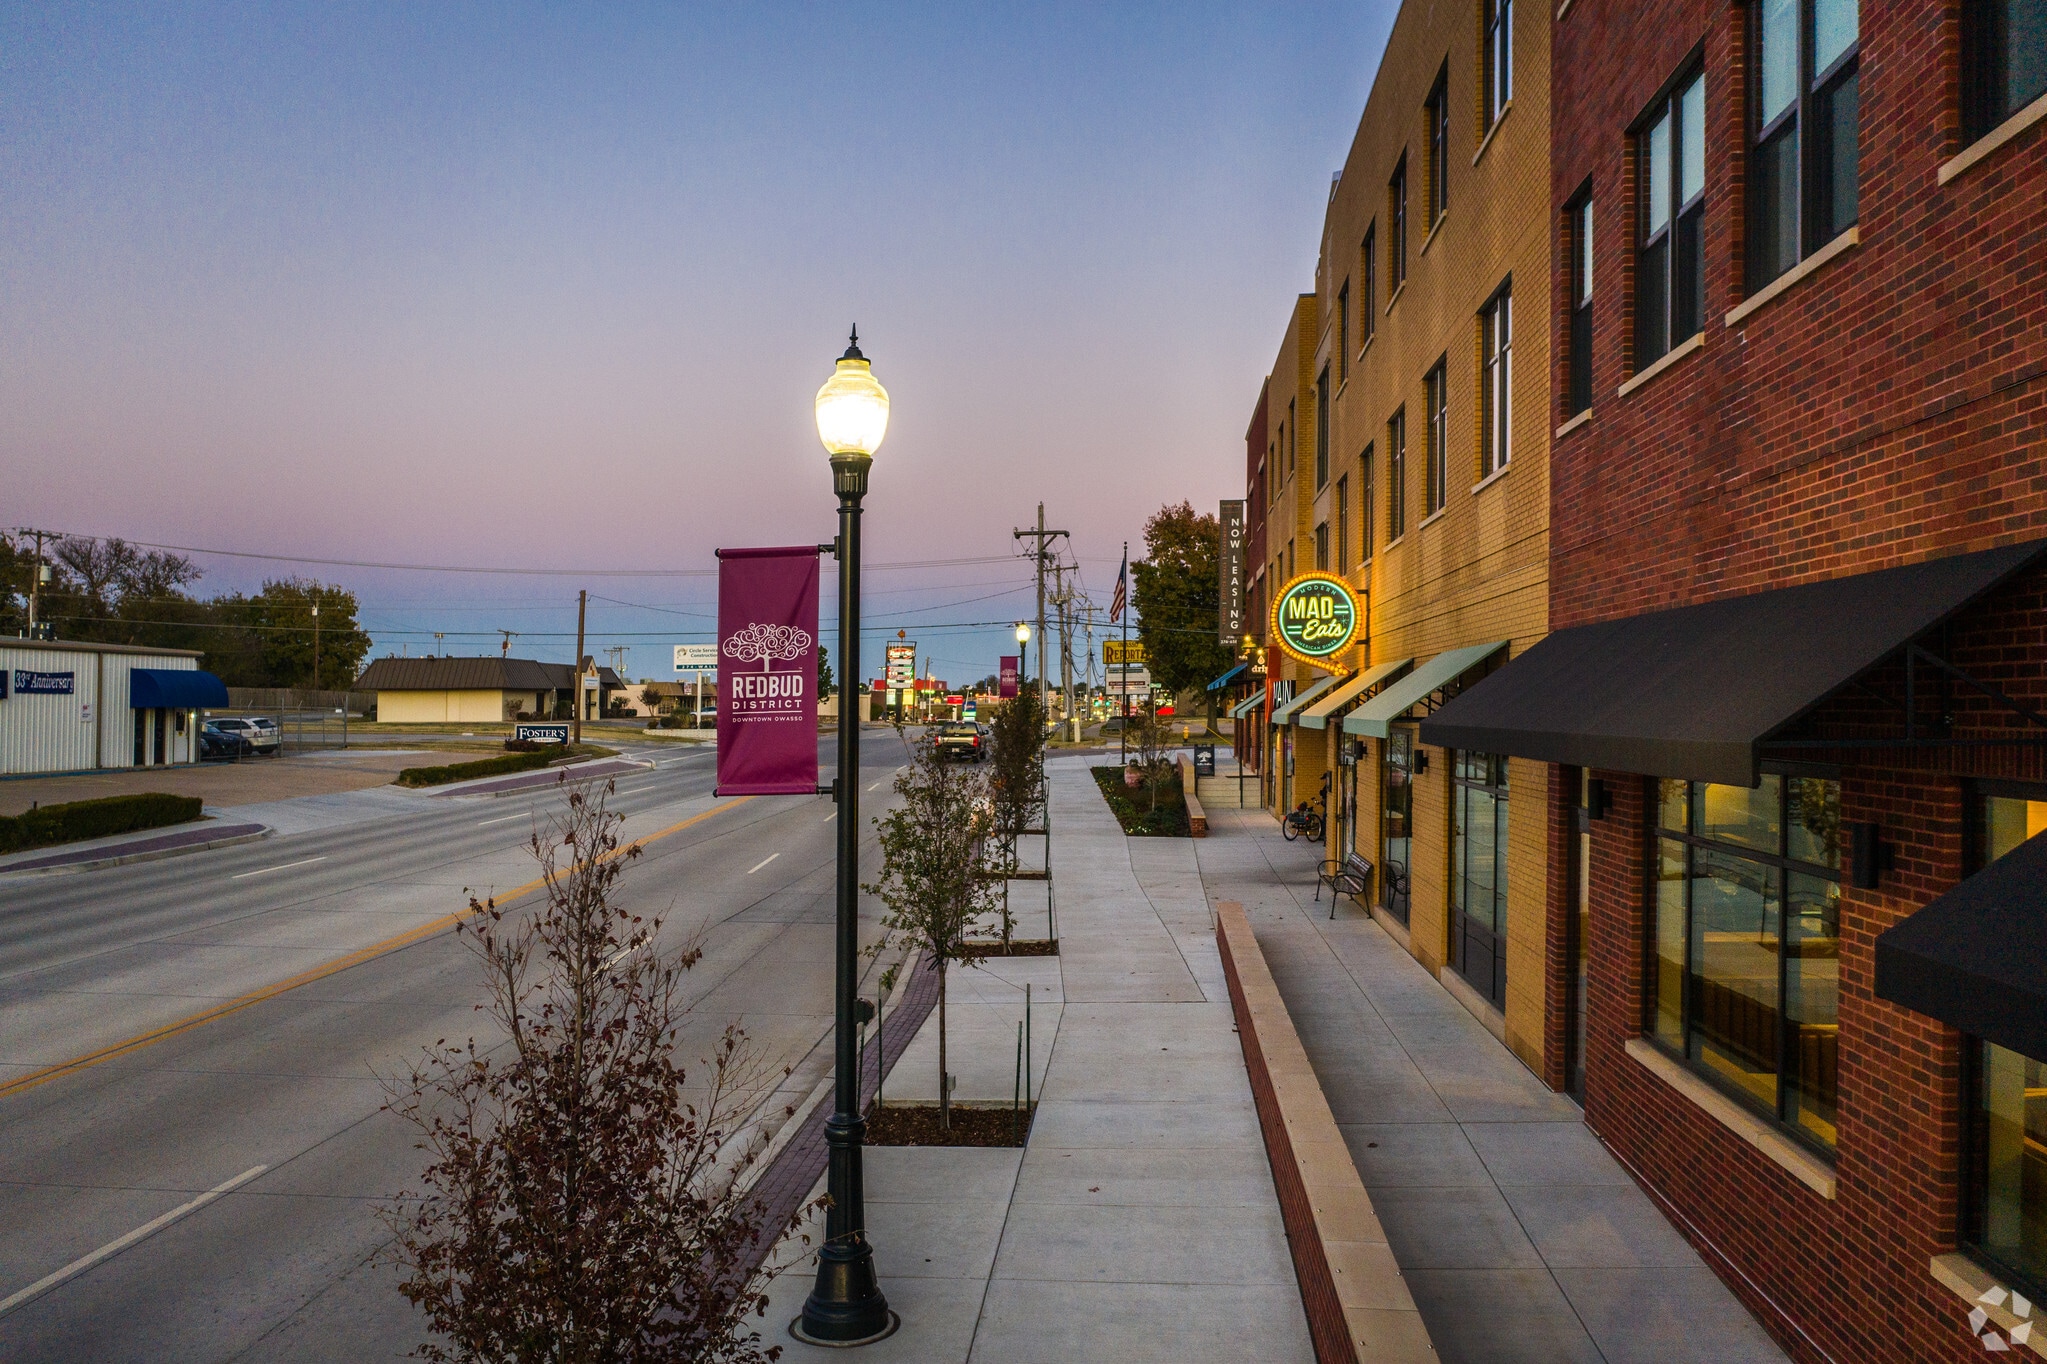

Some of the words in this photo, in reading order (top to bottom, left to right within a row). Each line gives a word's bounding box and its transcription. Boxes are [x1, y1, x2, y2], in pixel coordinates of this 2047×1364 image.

[1230, 518, 1240, 549] NOW
[1231, 555, 1239, 629] LEASING
[1300, 585, 1337, 596] MODERN
[1289, 596, 1334, 619] MAD
[1302, 618, 1347, 641] Eats
[1106, 646, 1151, 662] REPORTE
[1296, 640, 1321, 650] AMERICAN
[1322, 640, 1338, 650] DINER
[31, 674, 74, 692] Anniversary
[732, 675, 803, 699] REDBUD
[732, 700, 802, 710] DISTRICT
[519, 728, 566, 740] FOSTER'S
